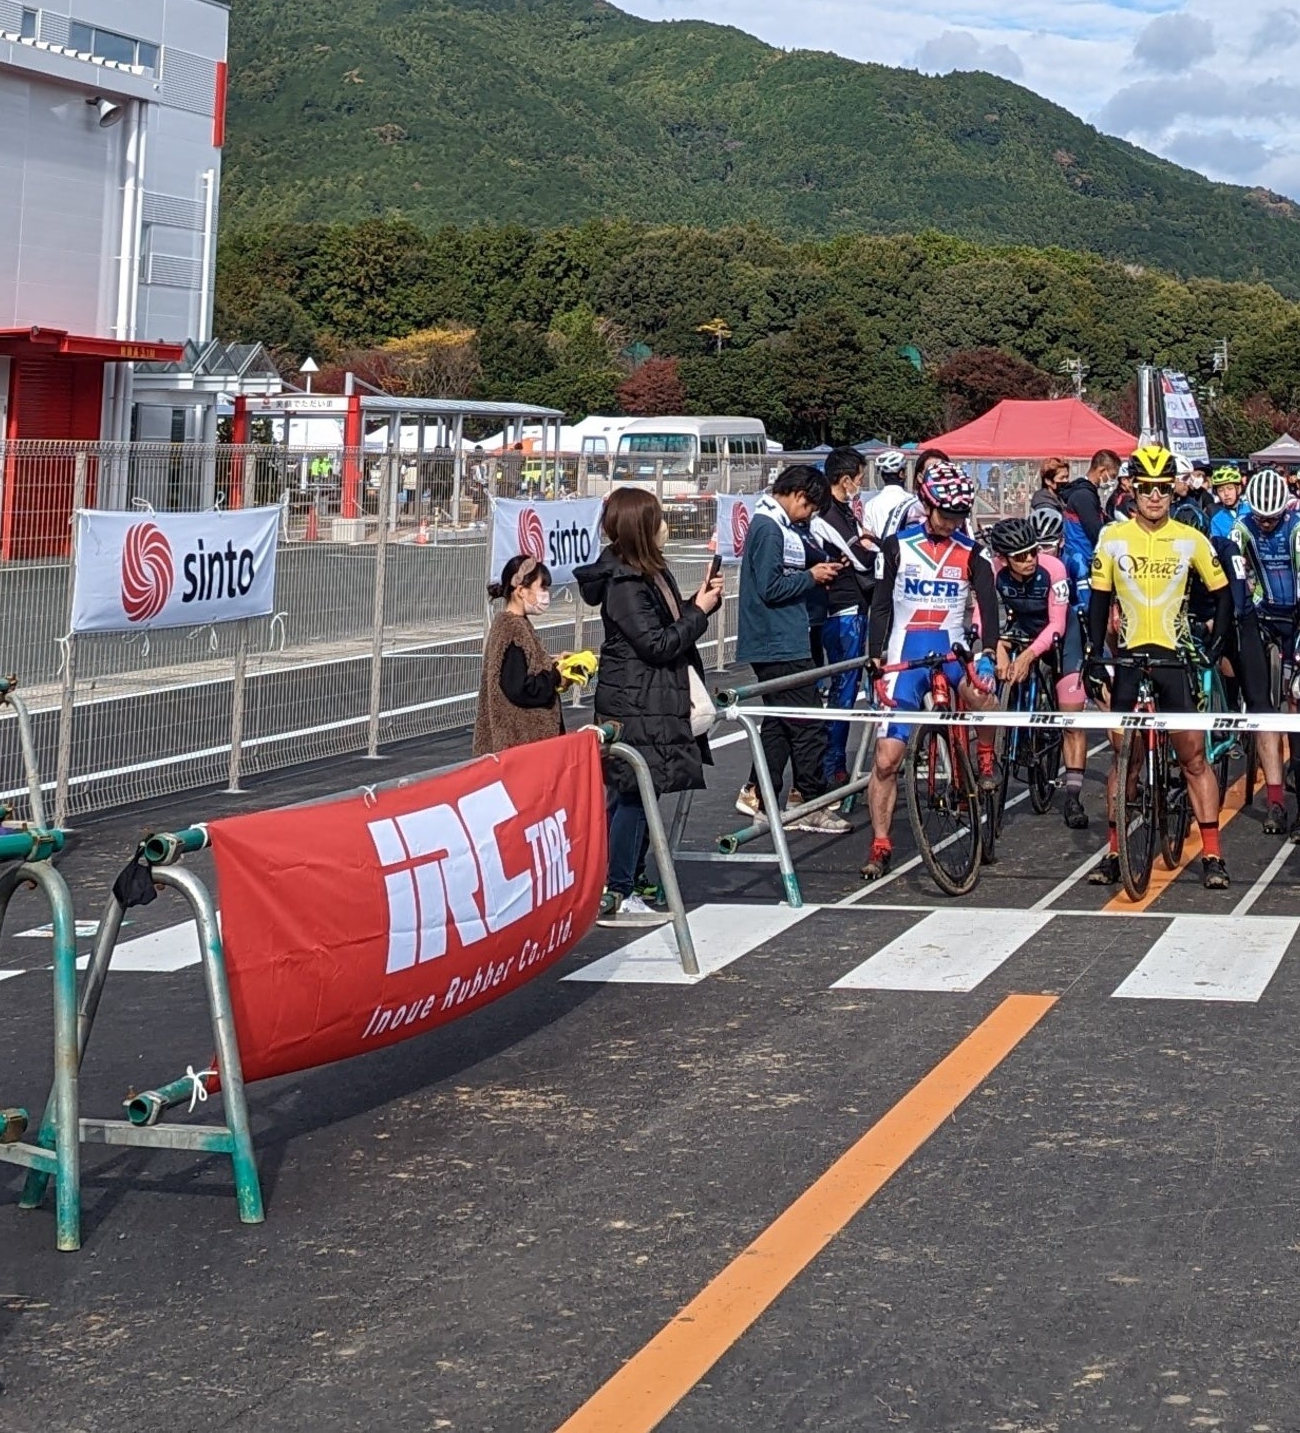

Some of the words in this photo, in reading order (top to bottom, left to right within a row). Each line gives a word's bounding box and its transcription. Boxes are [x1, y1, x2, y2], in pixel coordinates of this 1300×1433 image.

[182, 539, 255, 603] sinto
[550, 520, 591, 567] sinto
[904, 577, 960, 598] NCFR
[524, 808, 575, 907] TIRE
[362, 994, 435, 1040] Inoue
[441, 956, 515, 1012] Rubber
